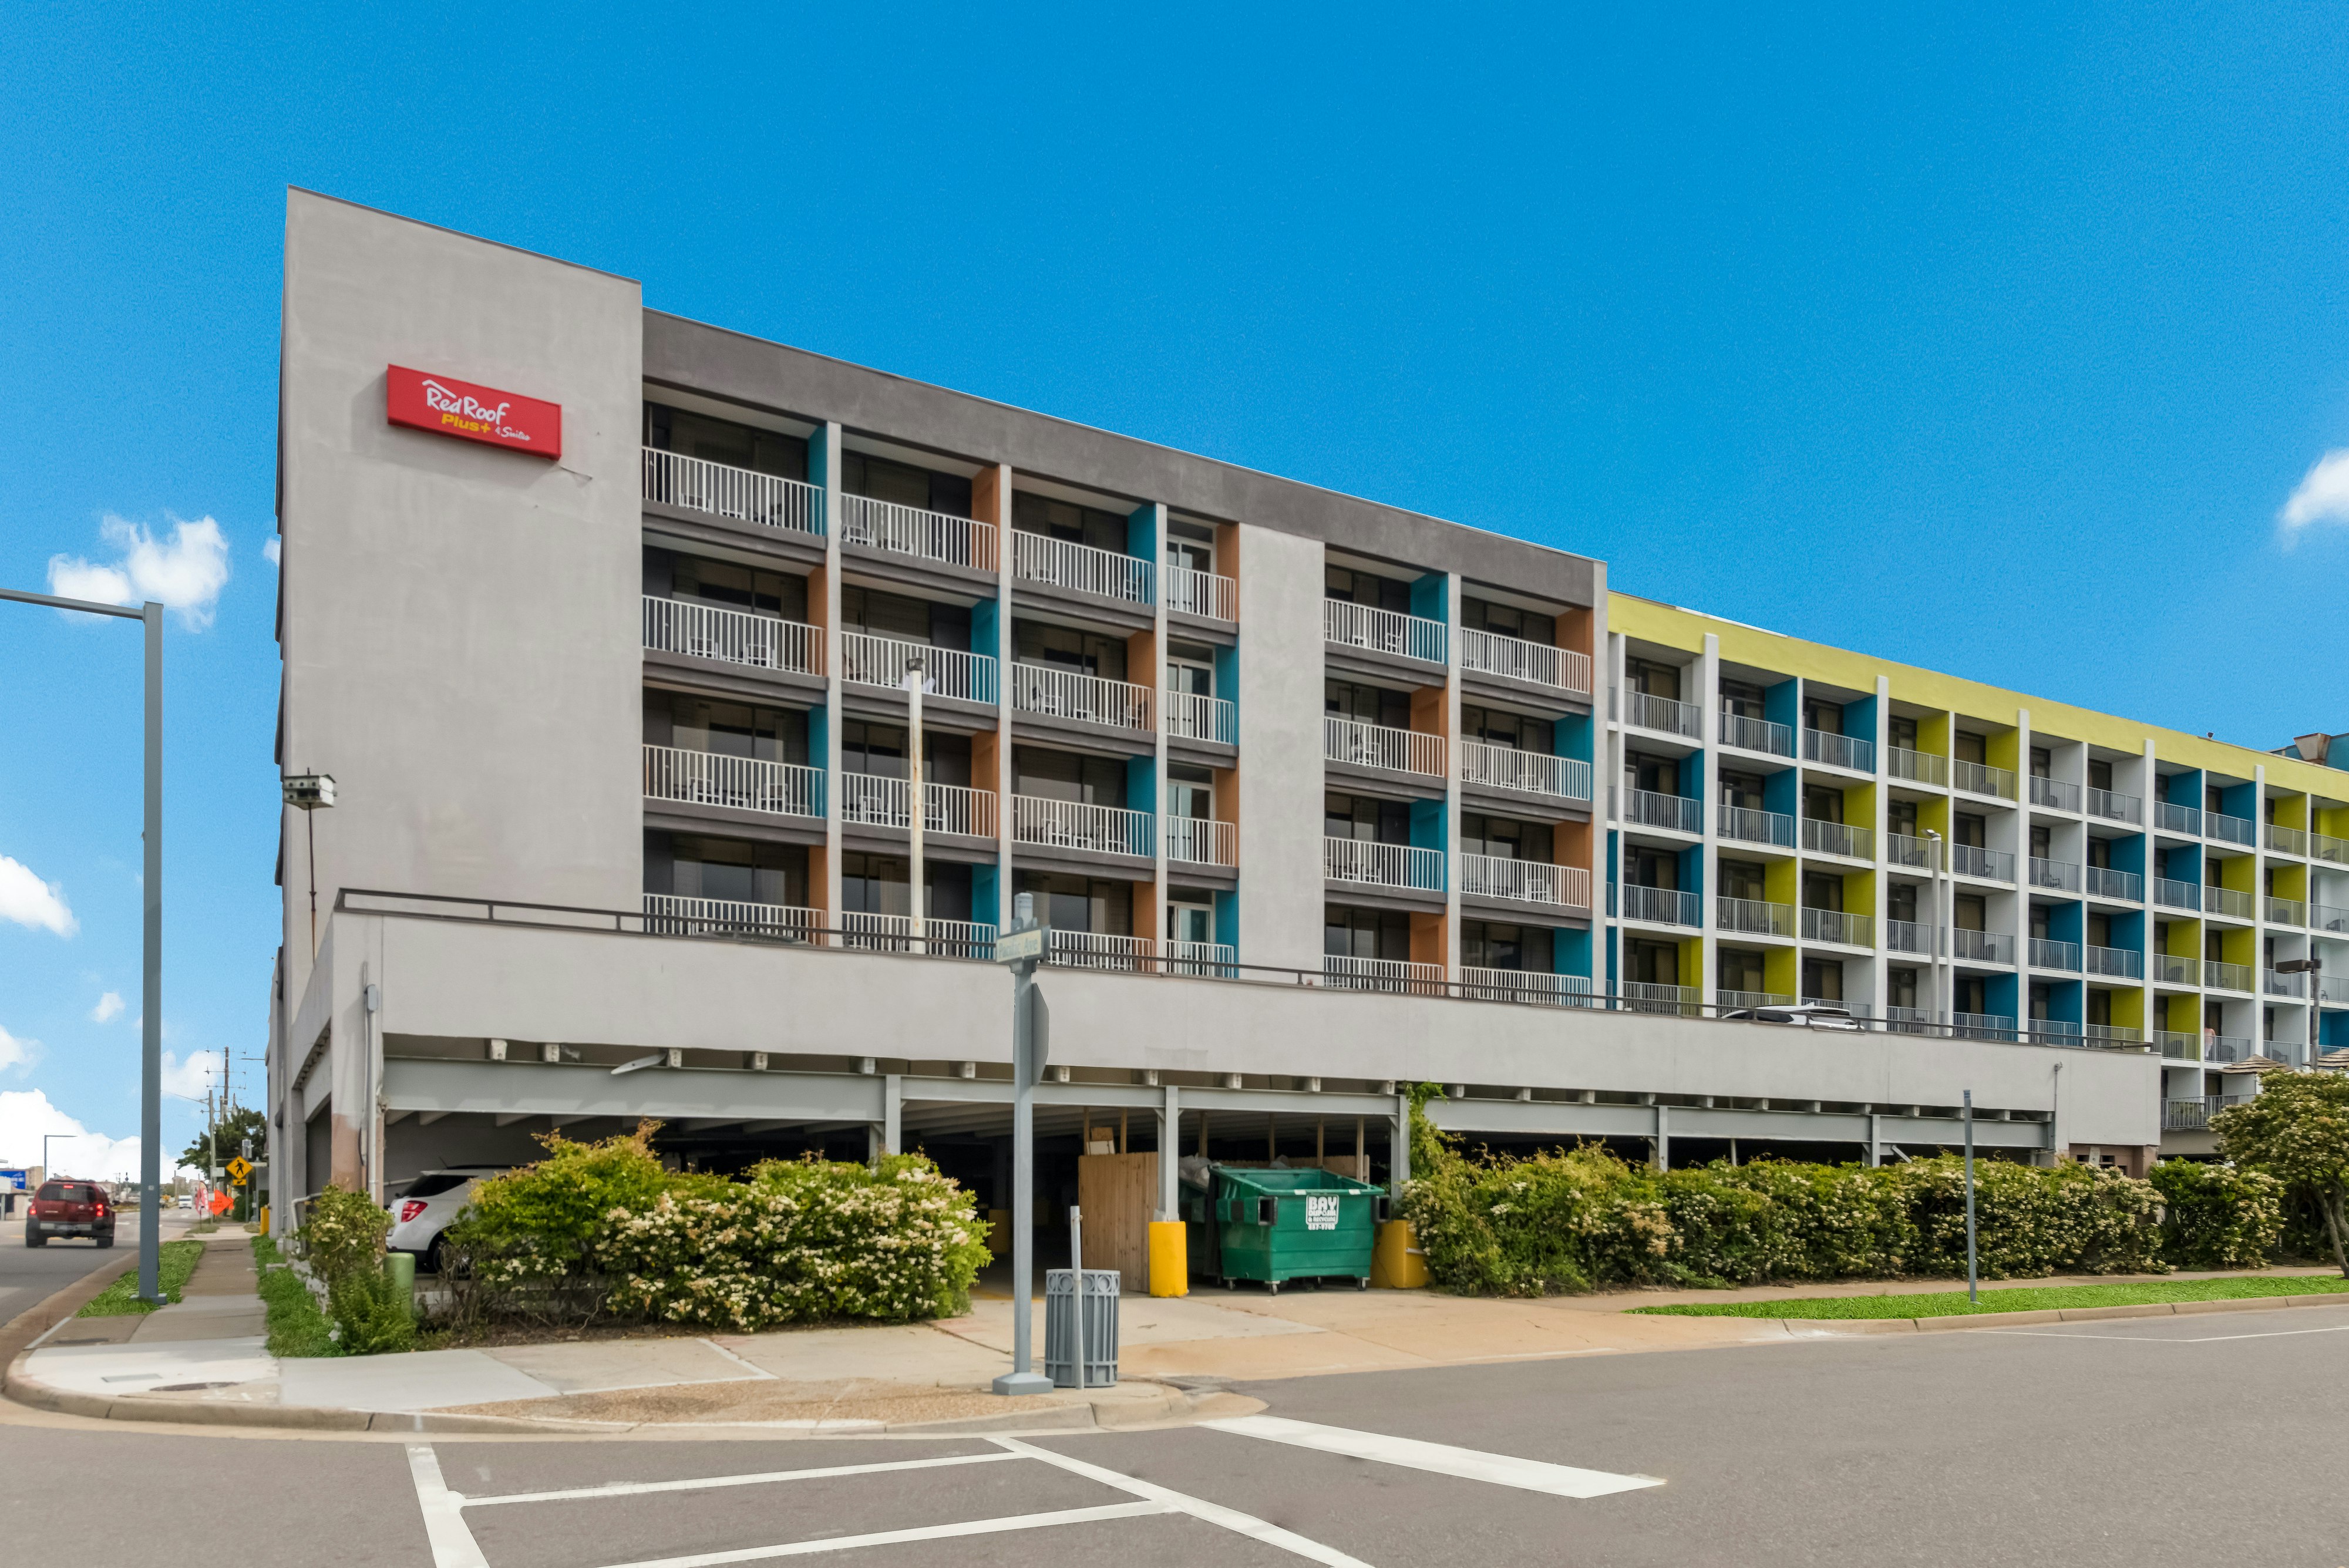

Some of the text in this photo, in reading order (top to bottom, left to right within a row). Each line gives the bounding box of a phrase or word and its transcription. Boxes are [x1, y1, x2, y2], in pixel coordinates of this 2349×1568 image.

[442, 413, 491, 433] Plus+
[999, 937, 1038, 958] Pacific Ave
[1308, 1196, 1337, 1210] BAY
